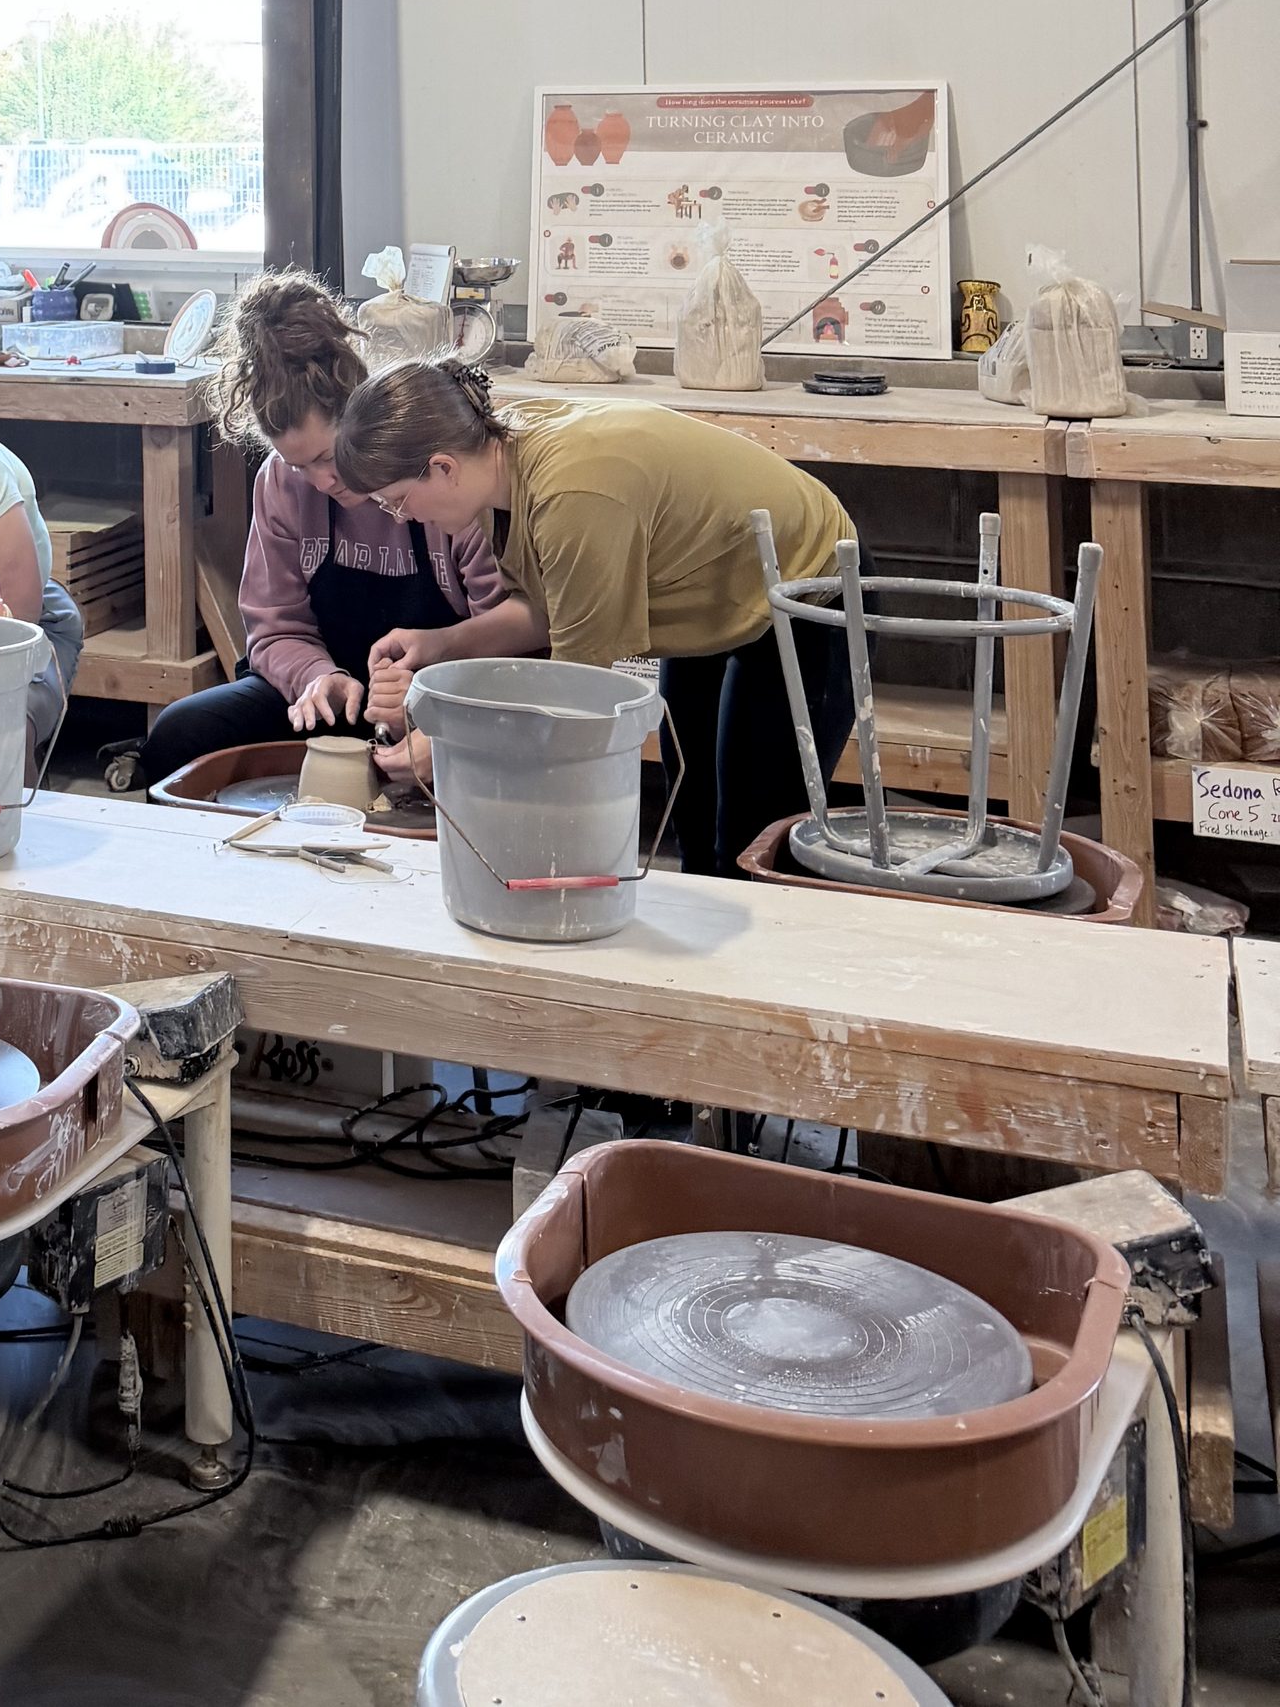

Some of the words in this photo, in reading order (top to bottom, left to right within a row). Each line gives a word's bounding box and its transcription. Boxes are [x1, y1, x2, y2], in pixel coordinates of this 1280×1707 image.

[682, 98, 697, 107] long
[698, 98, 714, 106] does
[715, 98, 727, 106] the
[759, 98, 786, 107] process
[646, 115, 725, 128] TURNING
[730, 115, 776, 128] CLAY
[782, 115, 824, 128] INTO
[693, 131, 774, 144] CERAMIC
[1197, 771, 1265, 800] Sedona
[1208, 802, 1243, 821] Cone
[1248, 804, 1261, 822] 5
[1199, 820, 1220, 834] Fired
